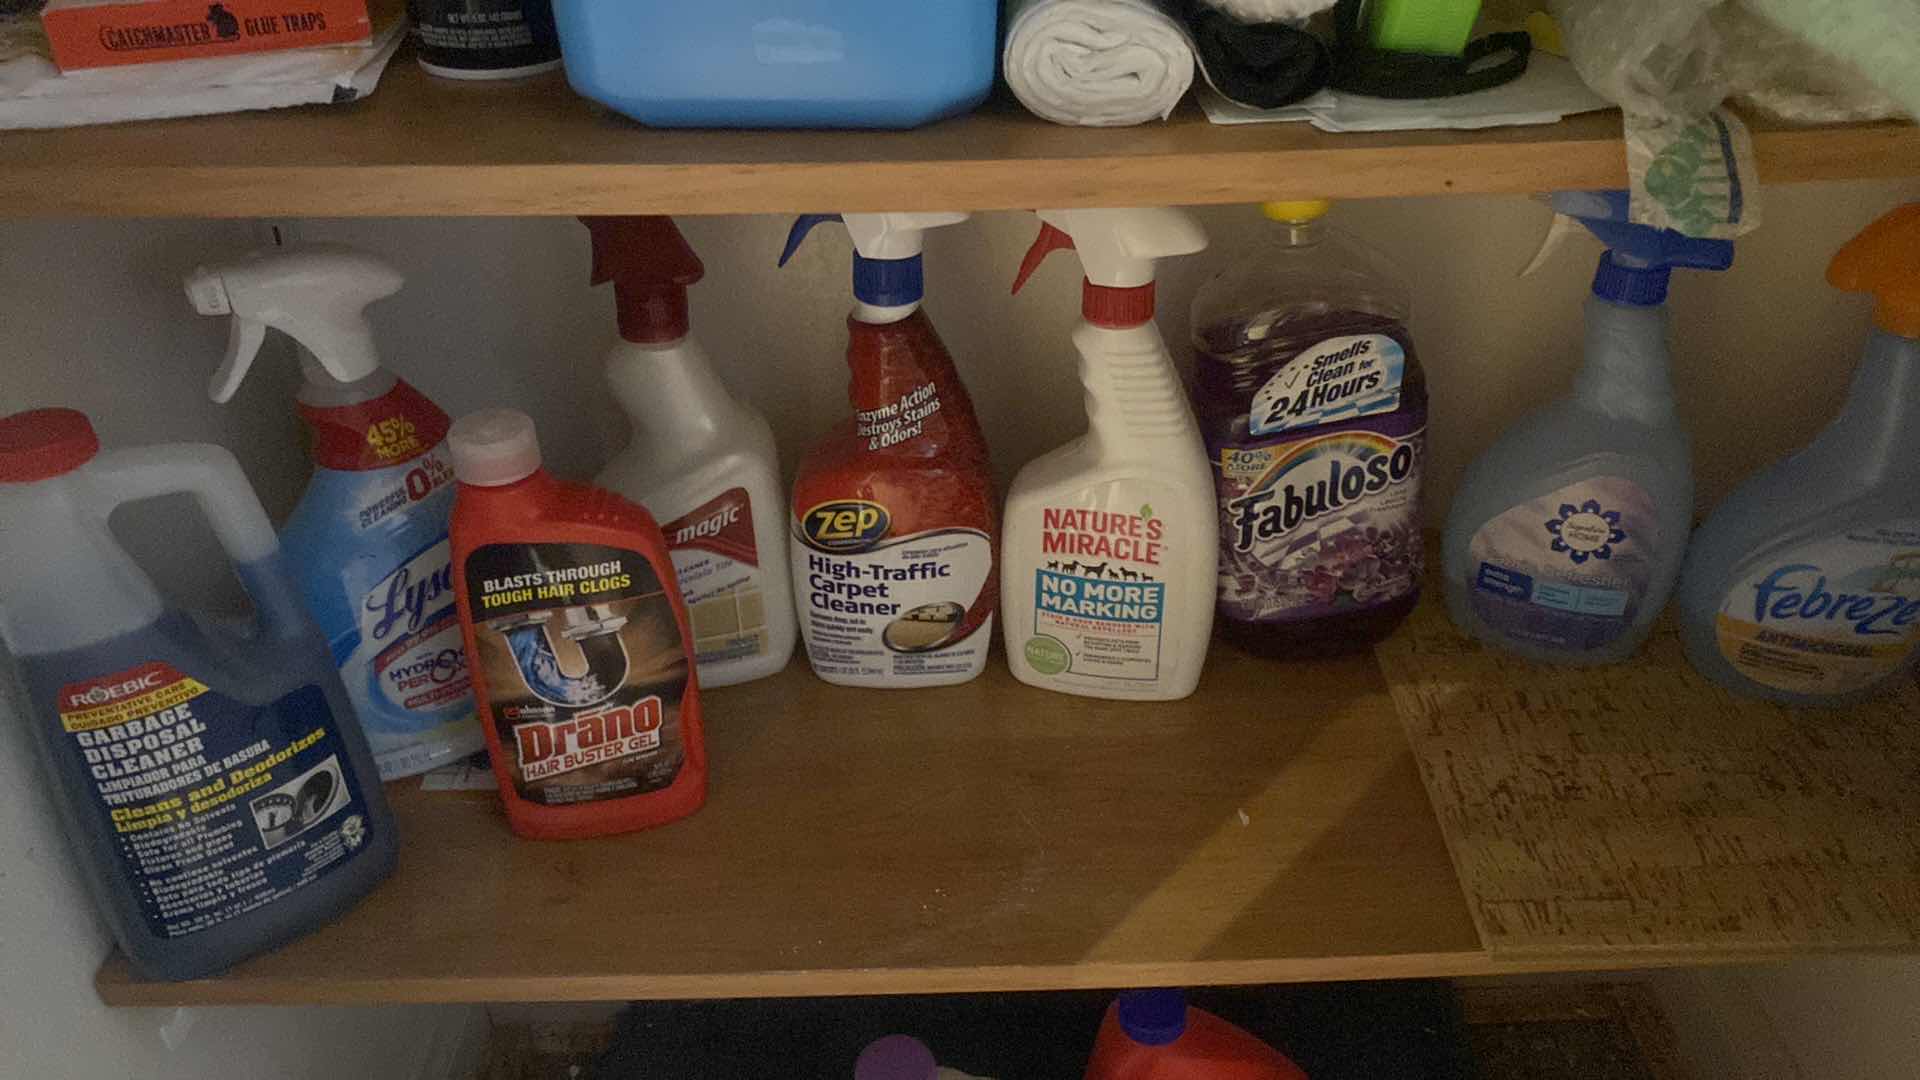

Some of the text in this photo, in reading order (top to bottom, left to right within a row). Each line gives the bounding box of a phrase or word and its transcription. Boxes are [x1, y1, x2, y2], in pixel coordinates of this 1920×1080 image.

[107, 13, 327, 49] CATCHMASTER GLUE TRAPS
[1311, 338, 1371, 371] Smells
[1306, 358, 1375, 387] Clean for
[899, 381, 936, 412] Action
[903, 397, 941, 425] Stains
[1265, 369, 1382, 426] 24 Hours
[367, 412, 416, 446] 45%
[868, 421, 922, 451] & Odors!
[376, 436, 422, 459] MORE
[1230, 444, 1413, 550] Fabuloso
[676, 505, 740, 545] magic
[1041, 531, 1161, 566] MIRACLE
[483, 560, 622, 594] BLASTS THROUGH
[808, 554, 951, 581] High-Traffic
[481, 574, 632, 608] TOUGH HAIR CLOGS
[809, 574, 889, 599] Carpet
[1041, 575, 1159, 604] NO MORE
[810, 592, 901, 616] Cleaner
[1041, 594, 1158, 620] MARKING
[69, 671, 163, 706] ROEBIC
[76, 702, 193, 748] GARBAGE
[83, 717, 208, 764] DISPOSAL
[90, 736, 206, 780] CLEANER
[97, 754, 208, 794] LIMPIADOR PARA
[103, 739, 272, 805] TRITURADORES DE BASURA
[525, 759, 561, 779] HAIR
[564, 743, 624, 769] BUSTER
[628, 735, 659, 751] GEL
[110, 799, 184, 823] Cleans
[114, 813, 174, 833] Limpia
[190, 772, 273, 812] desodoriza
